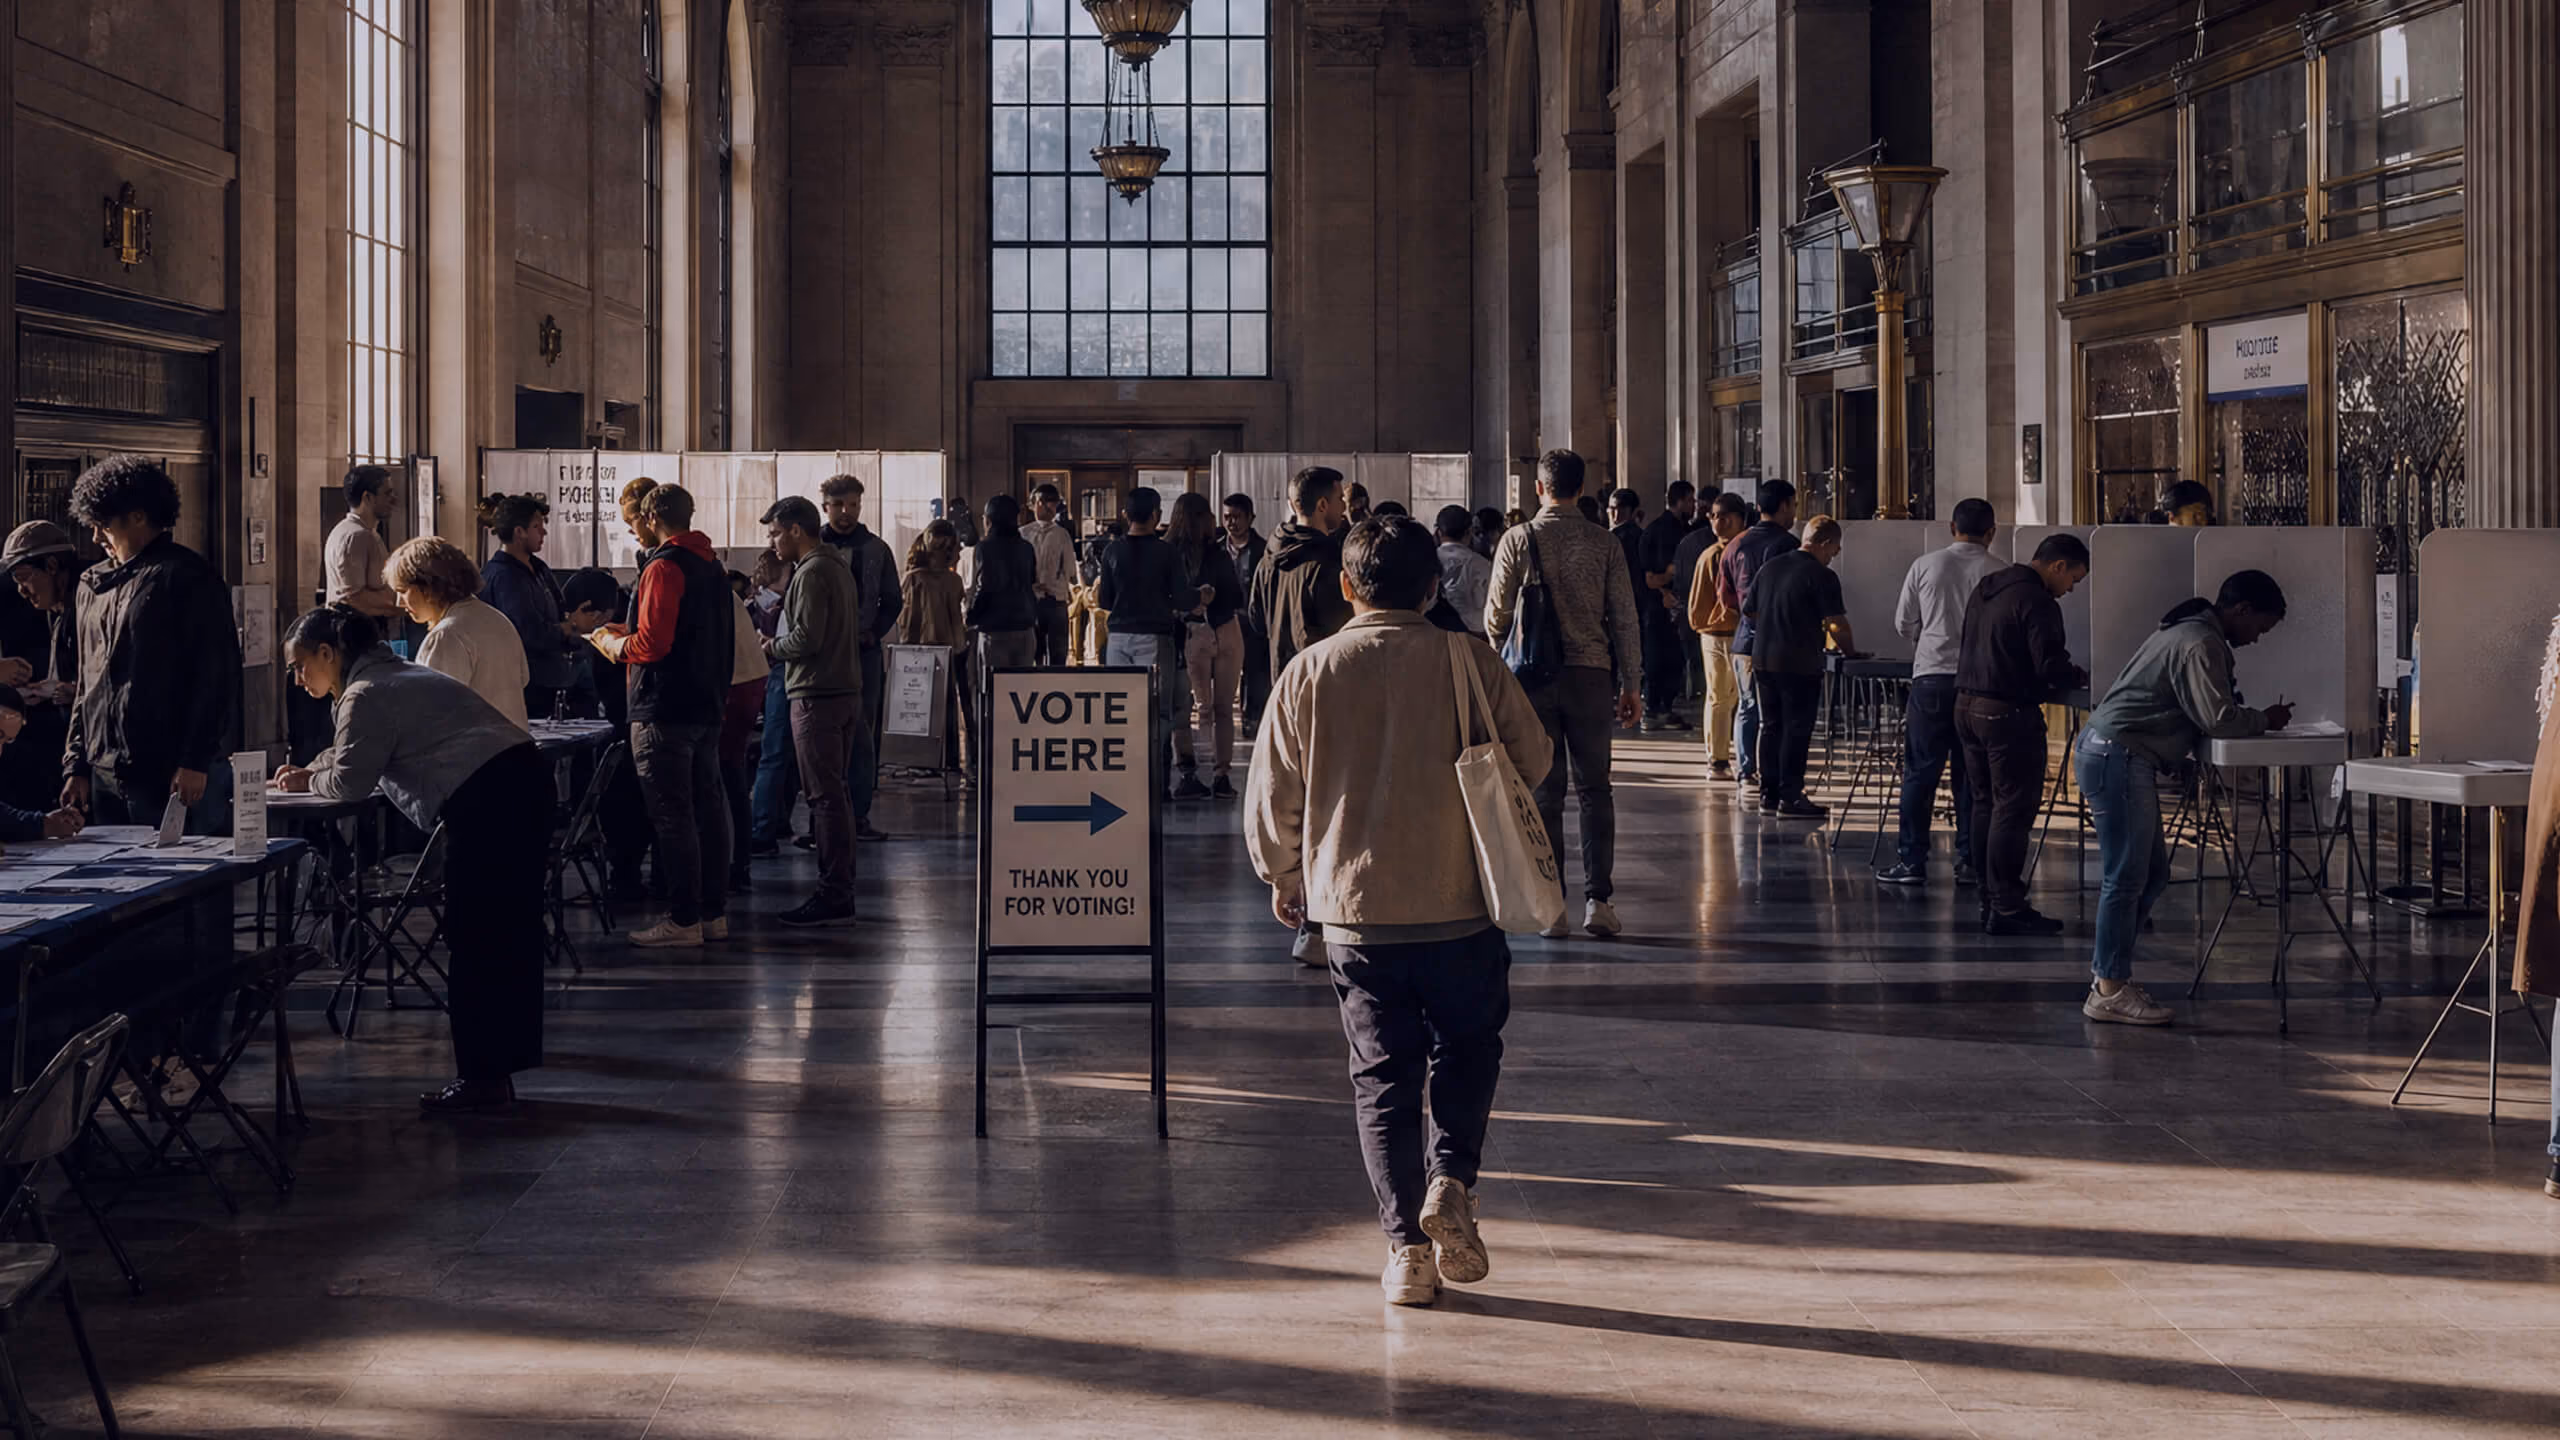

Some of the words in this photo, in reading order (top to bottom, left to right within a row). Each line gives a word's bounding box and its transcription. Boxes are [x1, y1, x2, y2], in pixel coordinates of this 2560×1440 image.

[1008, 690, 1129, 725] VOTE
[1011, 737, 1128, 772] HERE
[1008, 868, 1080, 889] THANK
[1085, 868, 1129, 889] YOU
[1004, 896, 1046, 917] FOR
[1051, 896, 1135, 917] VOTING!
